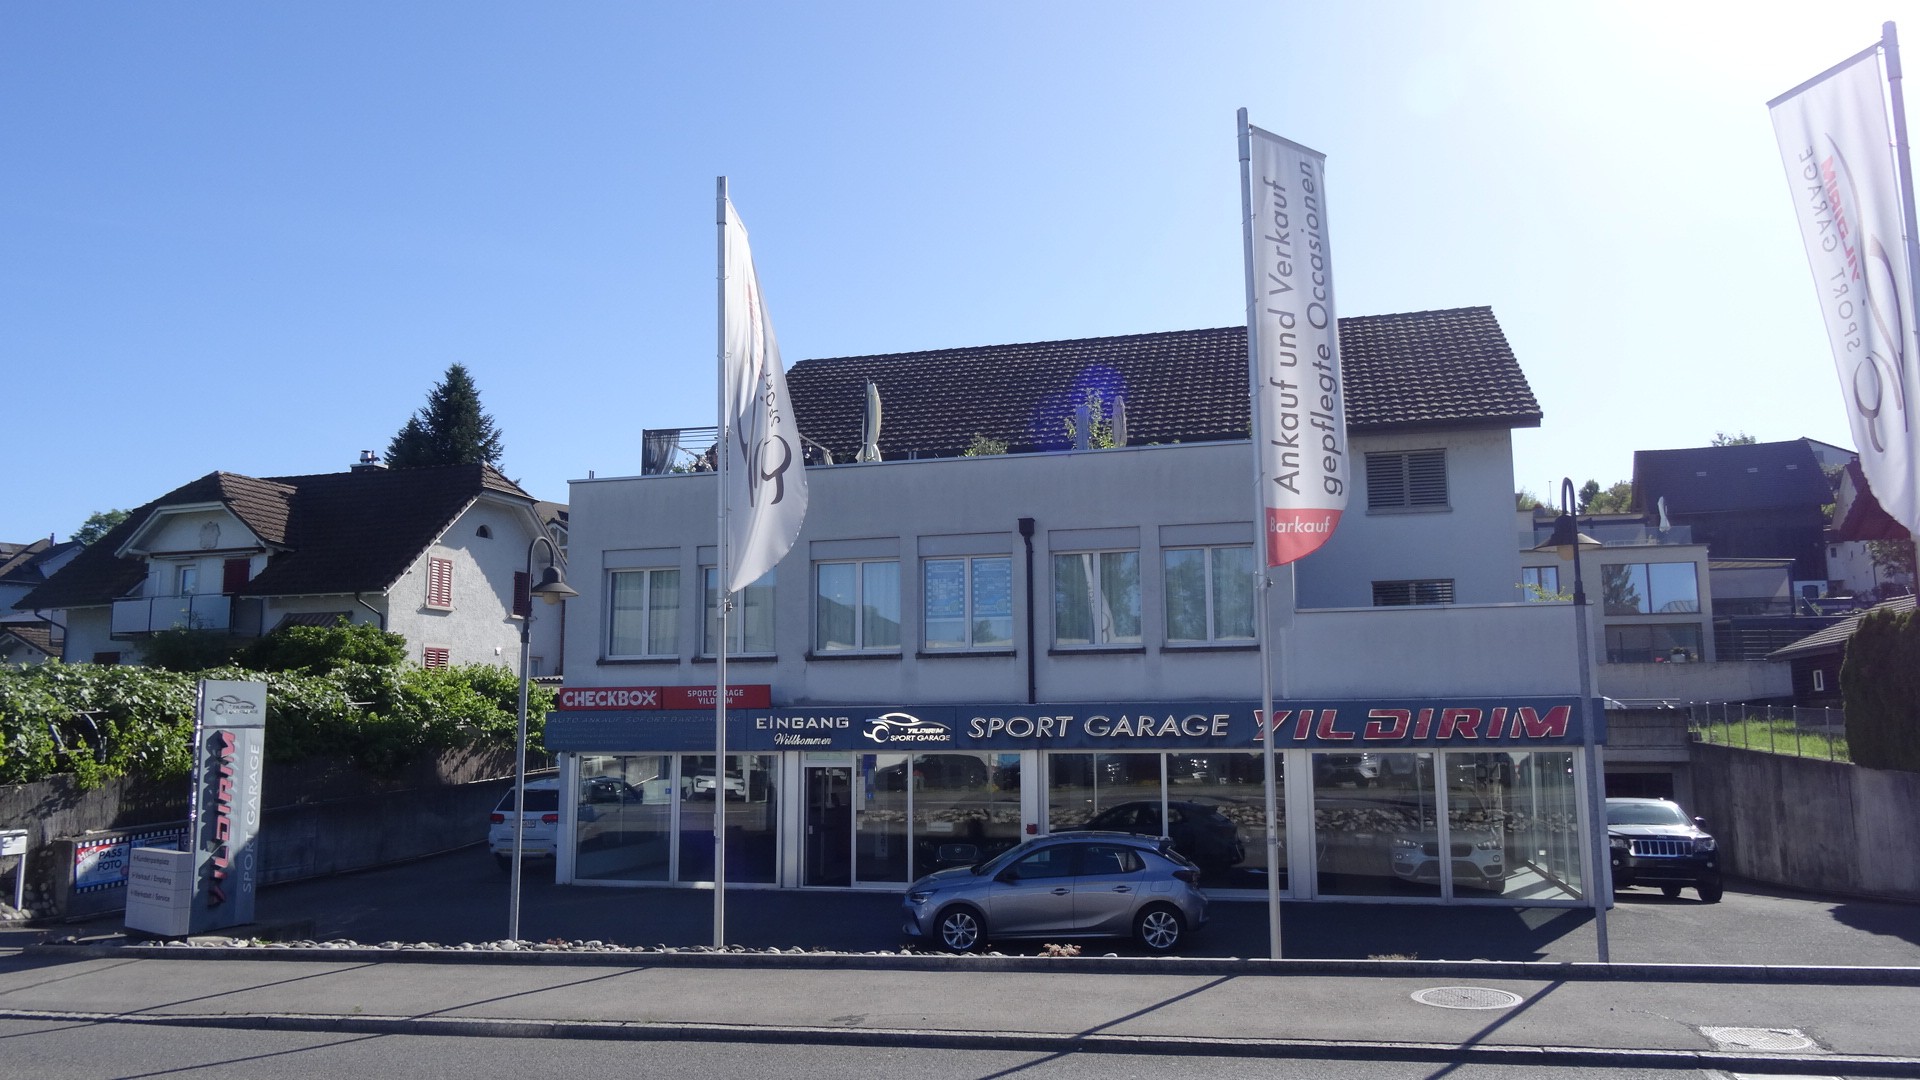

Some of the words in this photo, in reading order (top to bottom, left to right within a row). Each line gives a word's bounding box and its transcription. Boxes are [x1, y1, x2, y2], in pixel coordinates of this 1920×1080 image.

[1263, 176, 1294, 295] Verkauf
[1300, 161, 1328, 330] Occasionen
[1267, 308, 1298, 367] und
[1270, 376, 1300, 495] Ankauf
[1310, 344, 1343, 496] gepflegte
[1270, 515, 1330, 533] Barkauf
[562, 690, 657, 707] CHECKBOX
[687, 689, 744, 697] SPORTGRAGE
[756, 716, 849, 730] EINGANG
[774, 733, 832, 745] Willkommen
[967, 716, 1074, 738] SPORT
[1084, 714, 1230, 737] GARAGE
[1253, 705, 1571, 740] YILDIRIM
[247, 744, 260, 825] GARAGE
[97, 859, 122, 871] FOTO
[99, 848, 122, 860] PASS
[243, 831, 255, 893] SPORT
